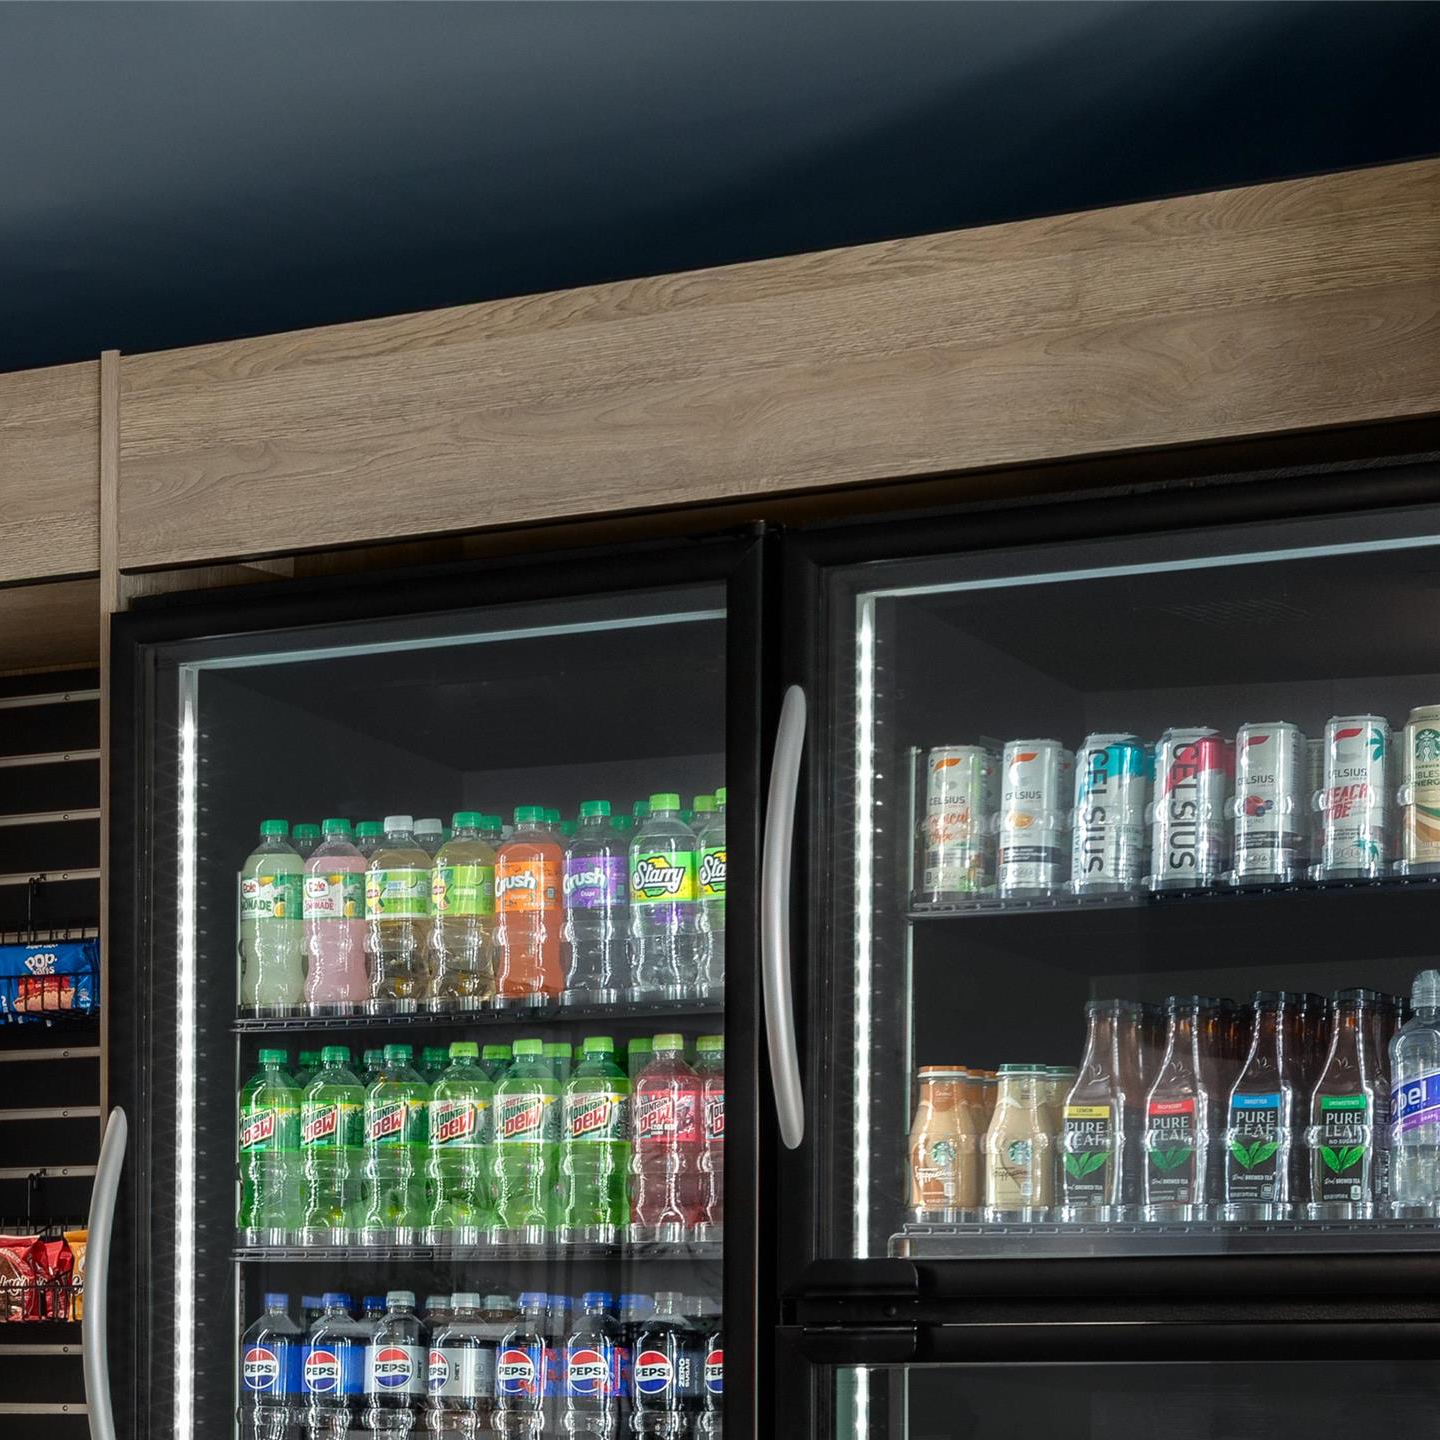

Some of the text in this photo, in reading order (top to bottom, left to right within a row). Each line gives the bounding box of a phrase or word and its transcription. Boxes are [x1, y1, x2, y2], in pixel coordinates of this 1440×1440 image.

[1328, 768, 1367, 779] CELSIUS
[1238, 775, 1274, 785] CELSIUS
[929, 796, 965, 805] CELSIUS
[1087, 749, 1109, 873] CELSIUS
[1169, 743, 1199, 870] CELSIUS
[633, 864, 684, 892] Starry
[1237, 1111, 1275, 1123] PURE
[1326, 1112, 1361, 1124] PURE
[1066, 1121, 1104, 1134] PURE
[1152, 1116, 1189, 1131] PURE
[1235, 1124, 1275, 1136] LEAF
[245, 1364, 276, 1373] PEPSI
[306, 1367, 339, 1376] PEPSI
[375, 1364, 410, 1373] PEPSI
[499, 1366, 532, 1376] PEPSI
[570, 1367, 606, 1376] PEPSI
[636, 1367, 667, 1377] PEPSI
